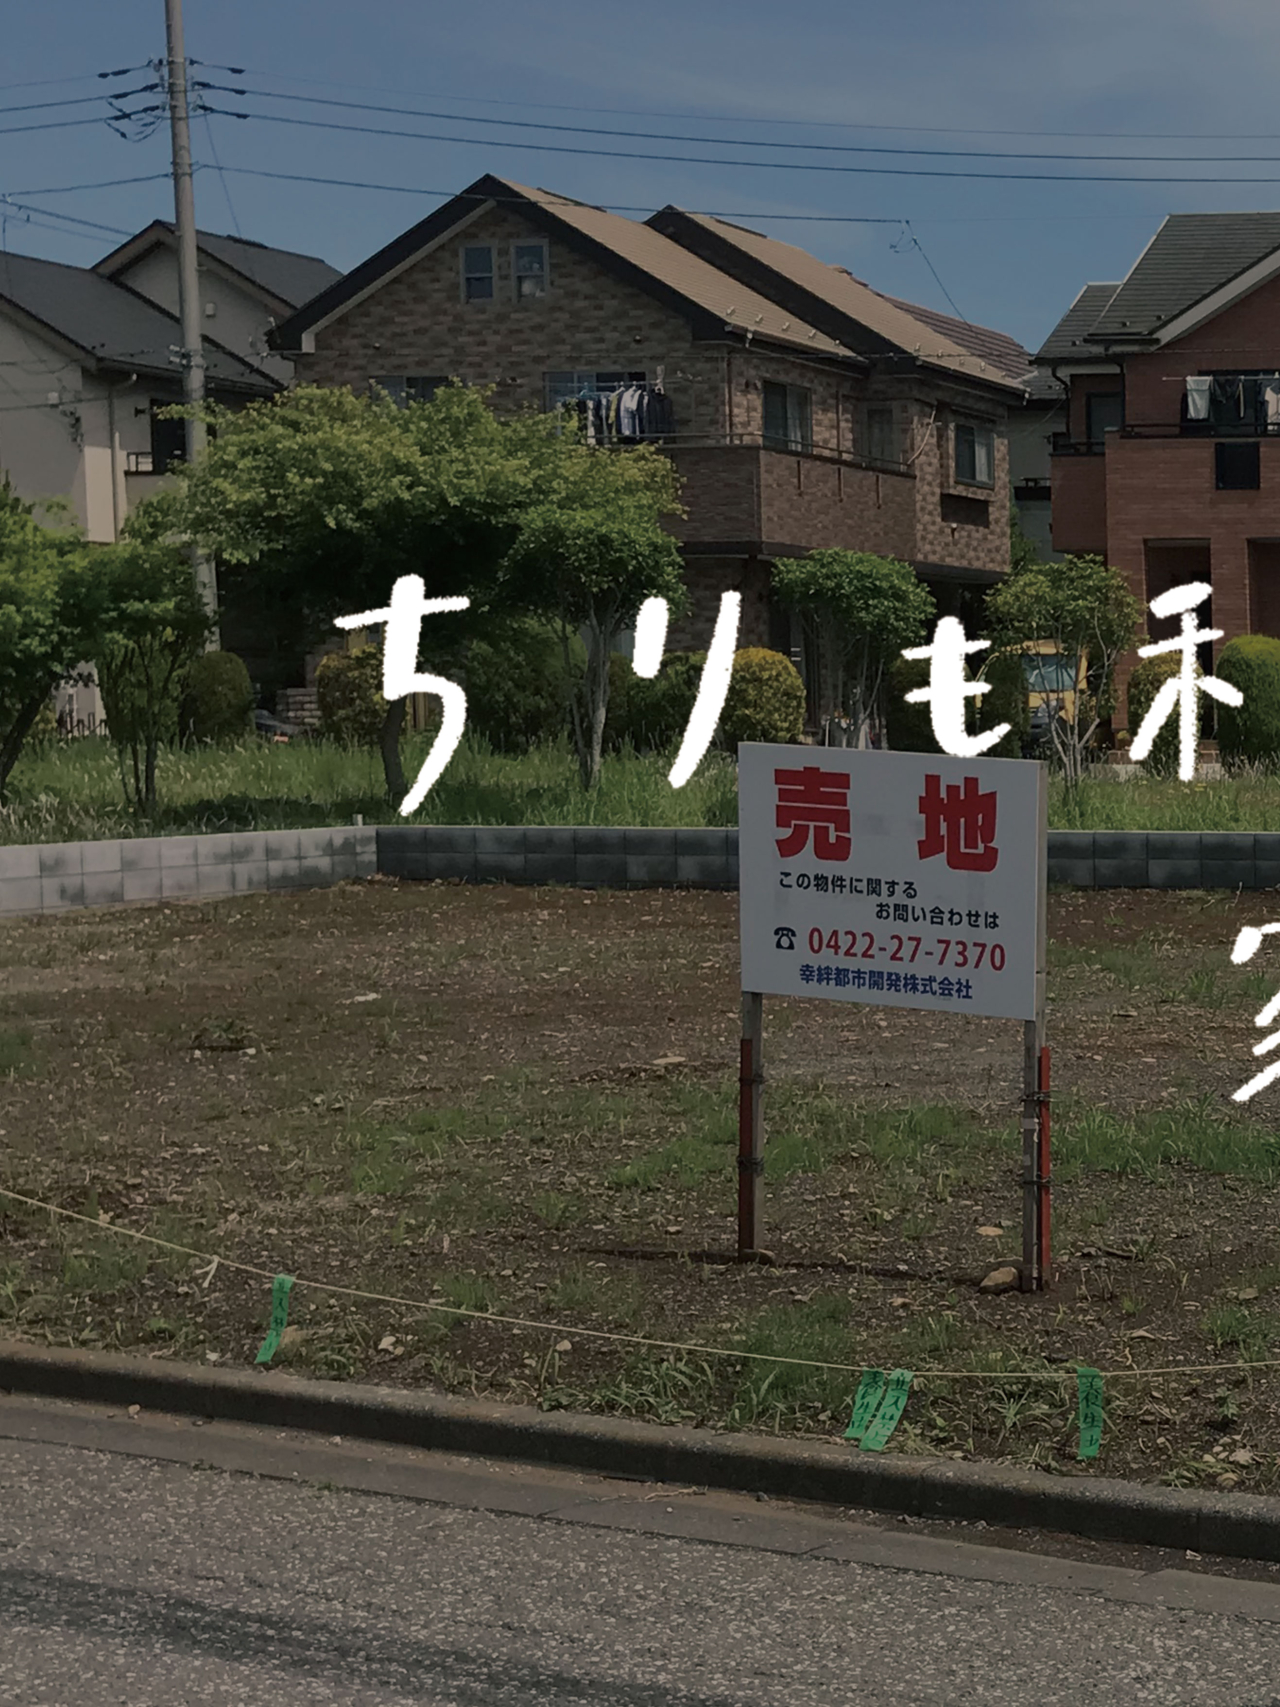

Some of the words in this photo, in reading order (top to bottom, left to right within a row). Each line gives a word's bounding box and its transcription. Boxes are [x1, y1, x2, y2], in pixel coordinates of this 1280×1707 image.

[774, 766, 999, 872] 売地
[779, 871, 918, 899] この物件に関する
[875, 902, 1000, 930] お問い合わせは
[808, 926, 1006, 972] 0422-27-7370
[799, 963, 973, 999] 幸絆都市開発株式会社
